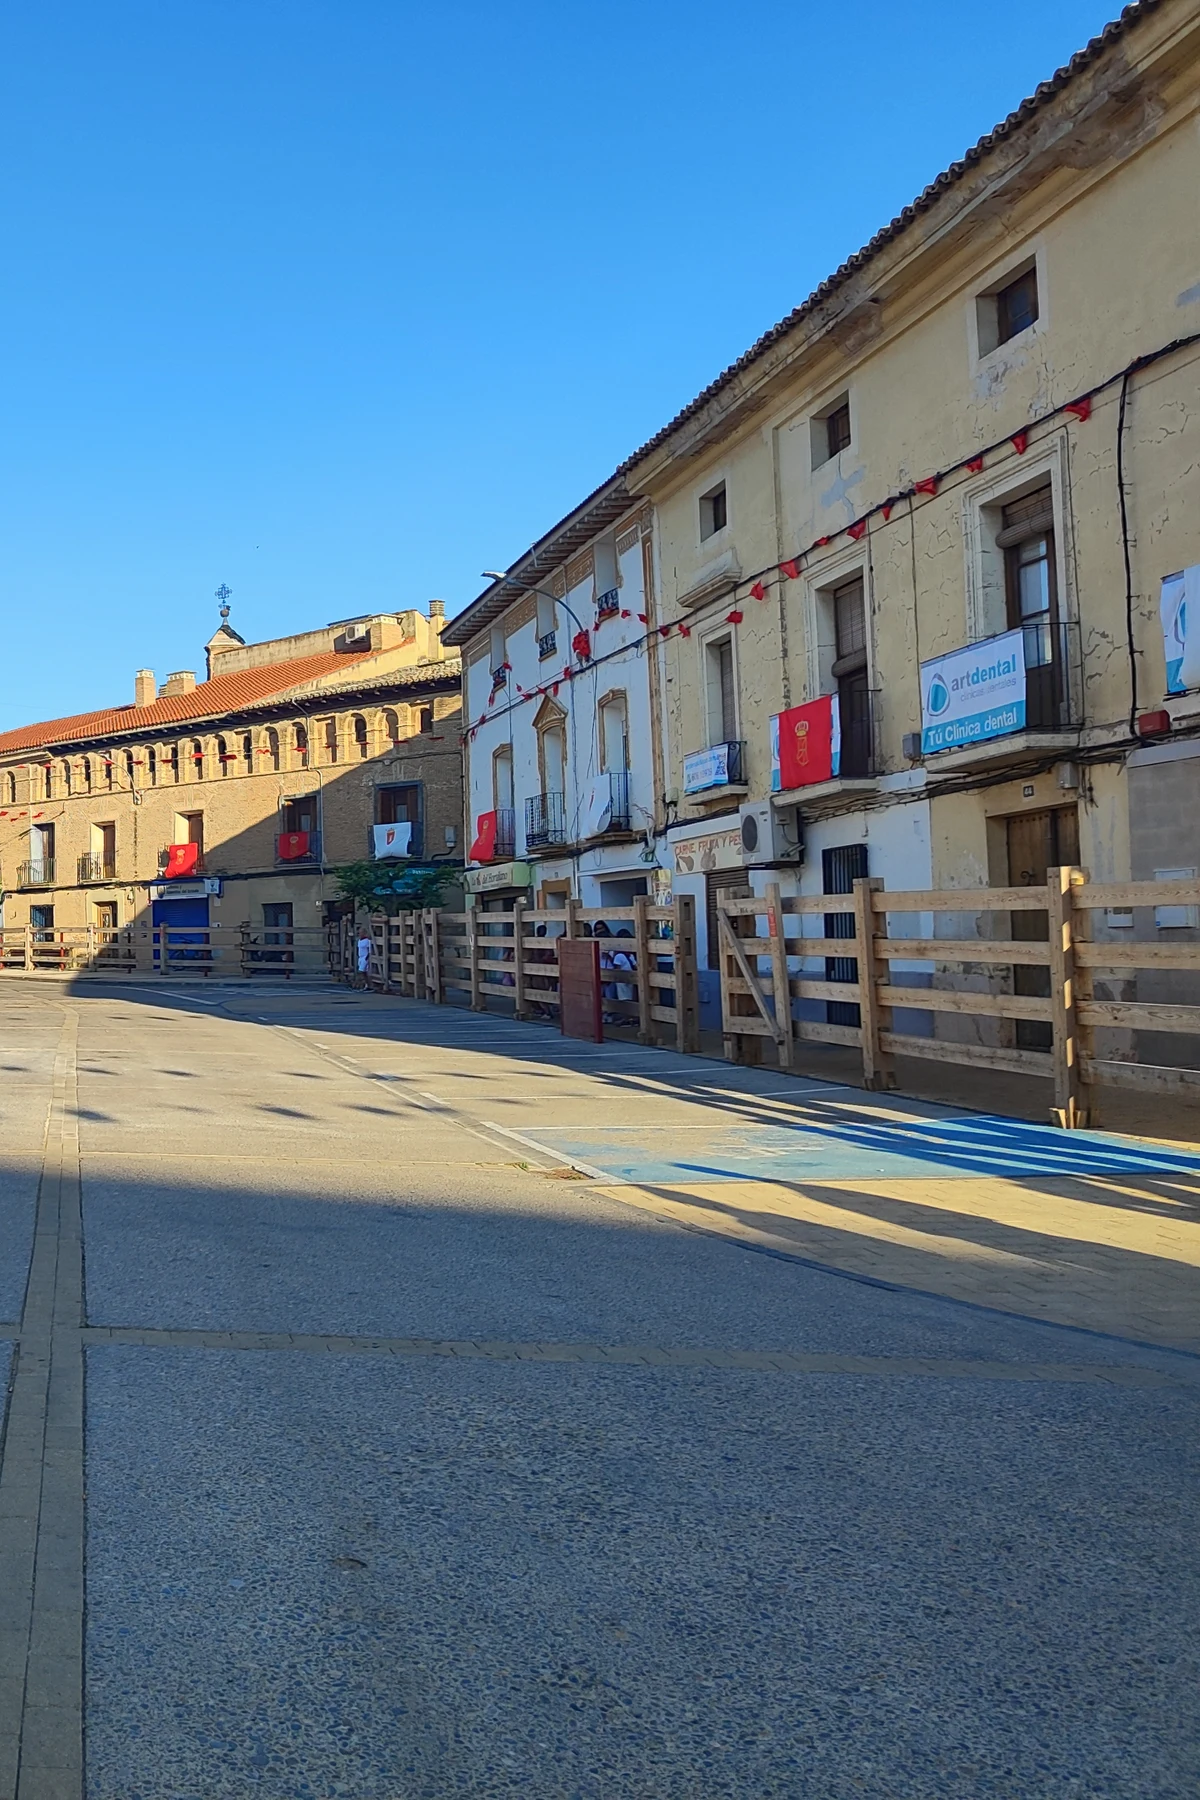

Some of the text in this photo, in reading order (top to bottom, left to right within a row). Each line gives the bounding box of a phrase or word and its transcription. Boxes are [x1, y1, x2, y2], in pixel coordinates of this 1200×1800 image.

[951, 653, 1017, 692] artdental
[928, 706, 1017, 746] Tú Clínica dental
[698, 838, 720, 852] FRUTA
[722, 835, 727, 847] Y
